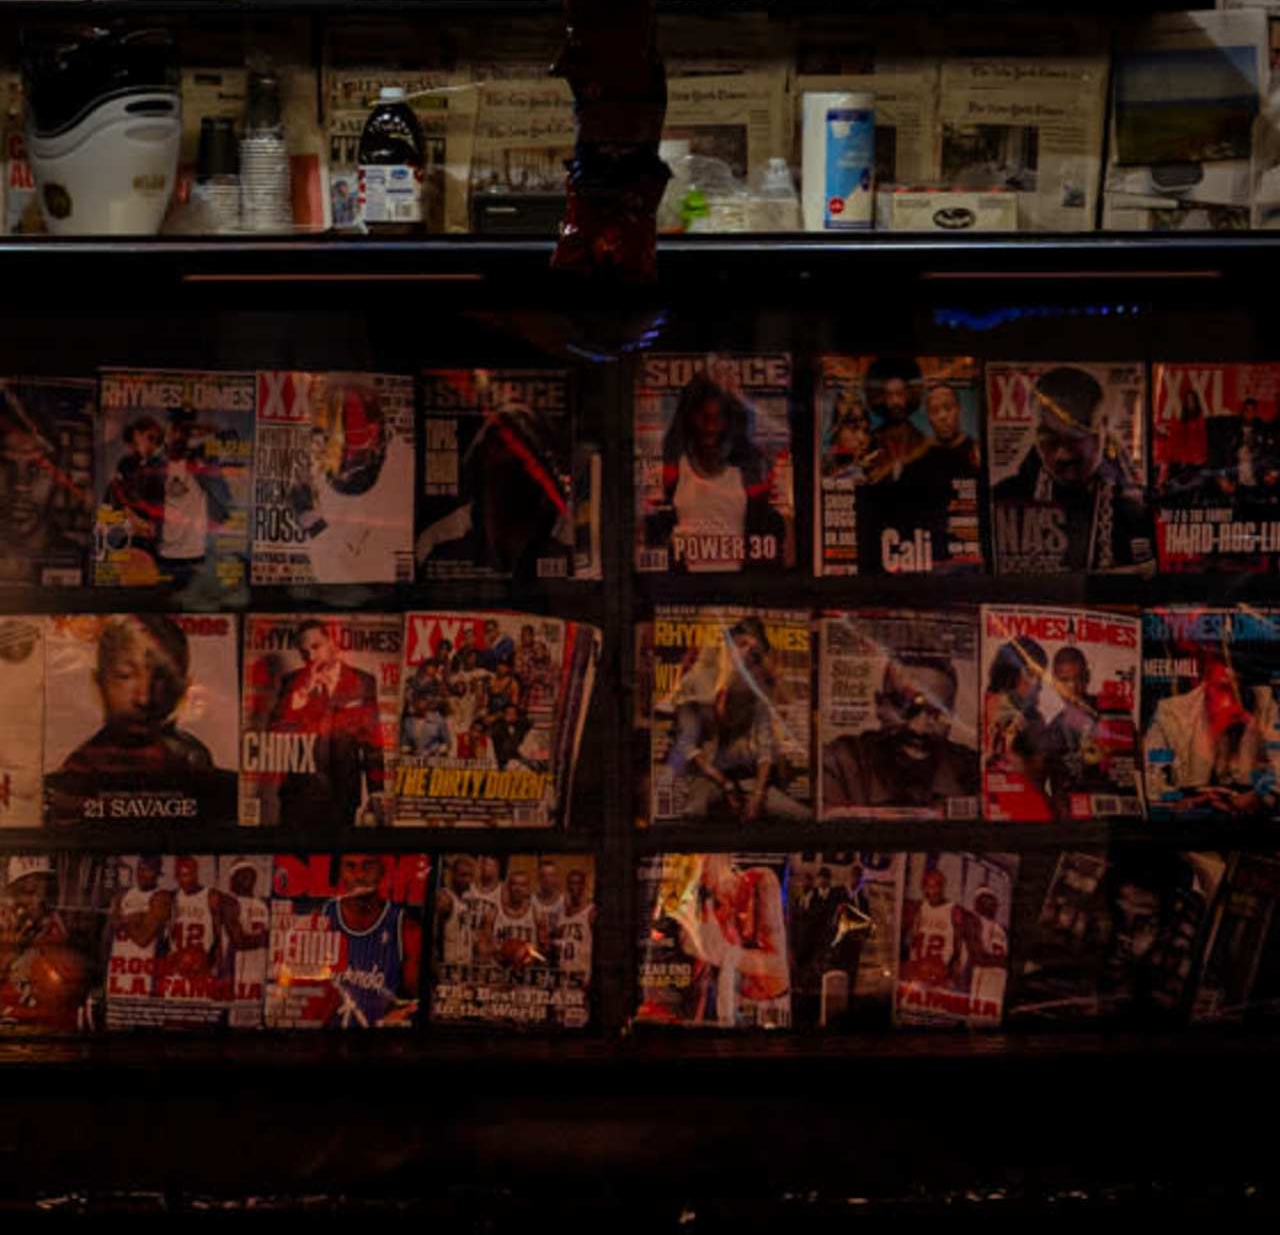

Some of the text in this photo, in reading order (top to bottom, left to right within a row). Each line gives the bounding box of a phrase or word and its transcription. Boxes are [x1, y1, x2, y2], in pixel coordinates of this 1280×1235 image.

[260, 372, 312, 421] XX
[992, 374, 1038, 421] XX
[255, 506, 307, 543] ROSS
[994, 508, 1069, 556] NAS
[674, 533, 777, 560] POWER 30
[880, 526, 933, 574] Cali
[242, 732, 318, 774] CHINX
[395, 766, 426, 797] THE
[429, 767, 485, 798] DIRTY
[84, 797, 198, 819] 21 SAVAGE
